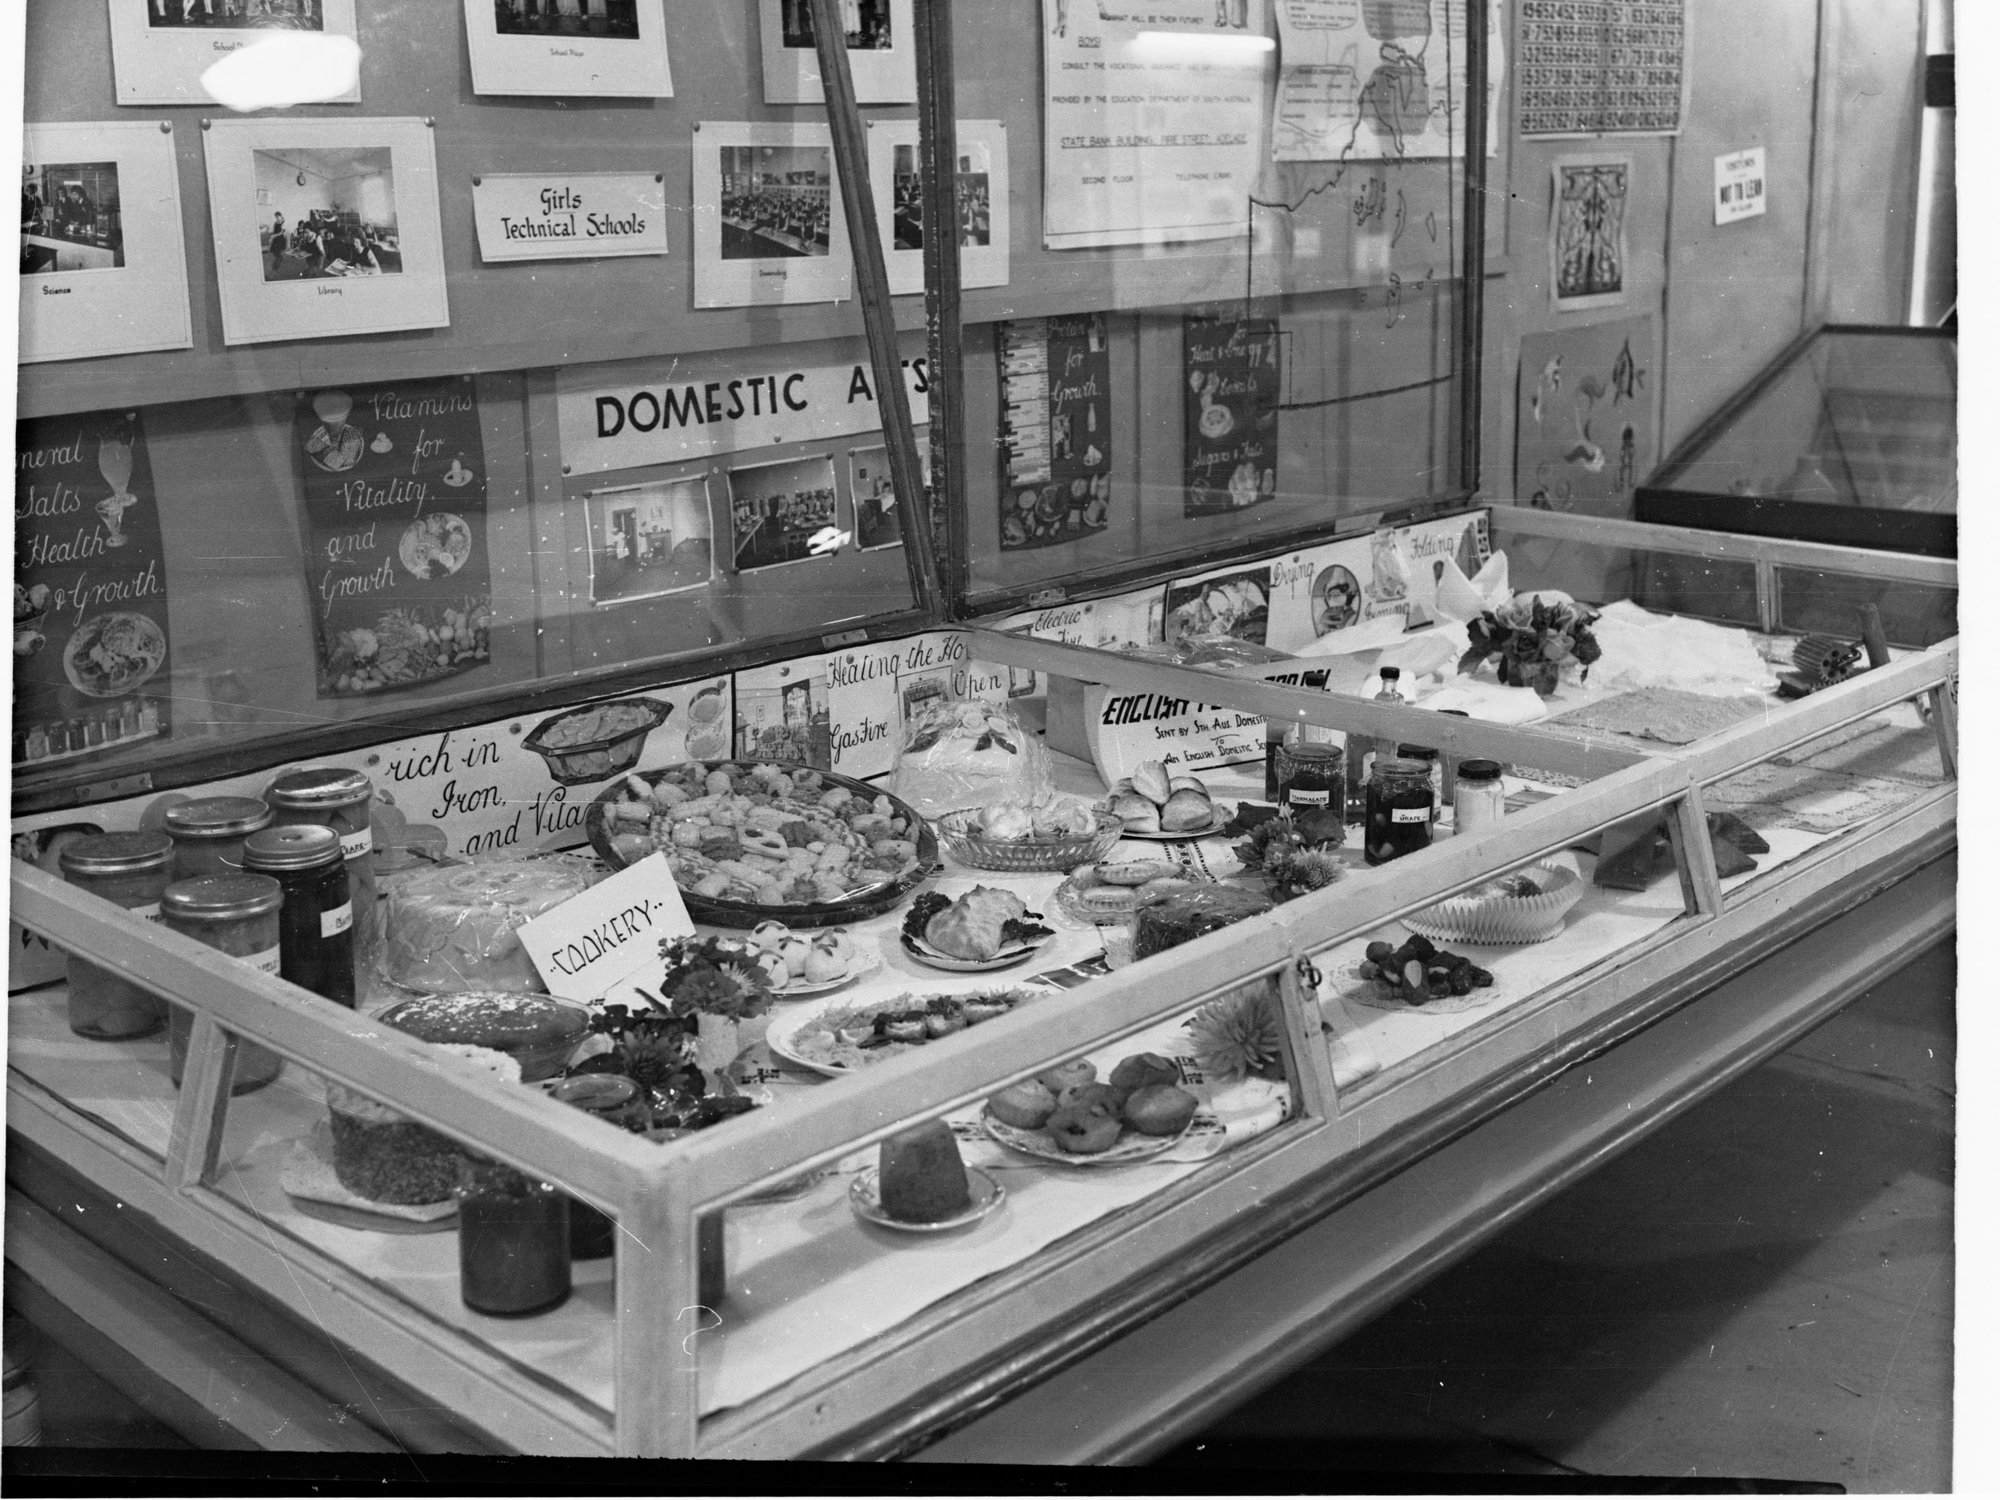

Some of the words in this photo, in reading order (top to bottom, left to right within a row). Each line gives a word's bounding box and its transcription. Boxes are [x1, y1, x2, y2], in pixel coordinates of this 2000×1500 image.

[540, 186, 582, 216] Girls
[500, 213, 577, 240] Technical
[586, 213, 646, 237] Schools
[42, 285, 72, 295] Science
[317, 286, 343, 296] Library
[368, 391, 472, 421] Vitamins
[595, 373, 809, 438] DOMESTIC
[412, 428, 446, 475] for
[16, 482, 81, 519] Salts
[21, 525, 105, 568] Health
[325, 521, 378, 557] and
[1410, 533, 1454, 560] Folding
[318, 556, 396, 619] Growth
[1270, 562, 1315, 600] Drying
[1035, 610, 1081, 632] Electric
[827, 653, 901, 694] Heating
[906, 639, 933, 669] the
[954, 670, 1002, 700] Open
[1102, 693, 1190, 725] ENGLISH
[385, 732, 453, 781] rich
[461, 738, 500, 767] in
[432, 780, 507, 819] Iron,
[460, 810, 522, 856] and
[528, 786, 593, 836] Vita
